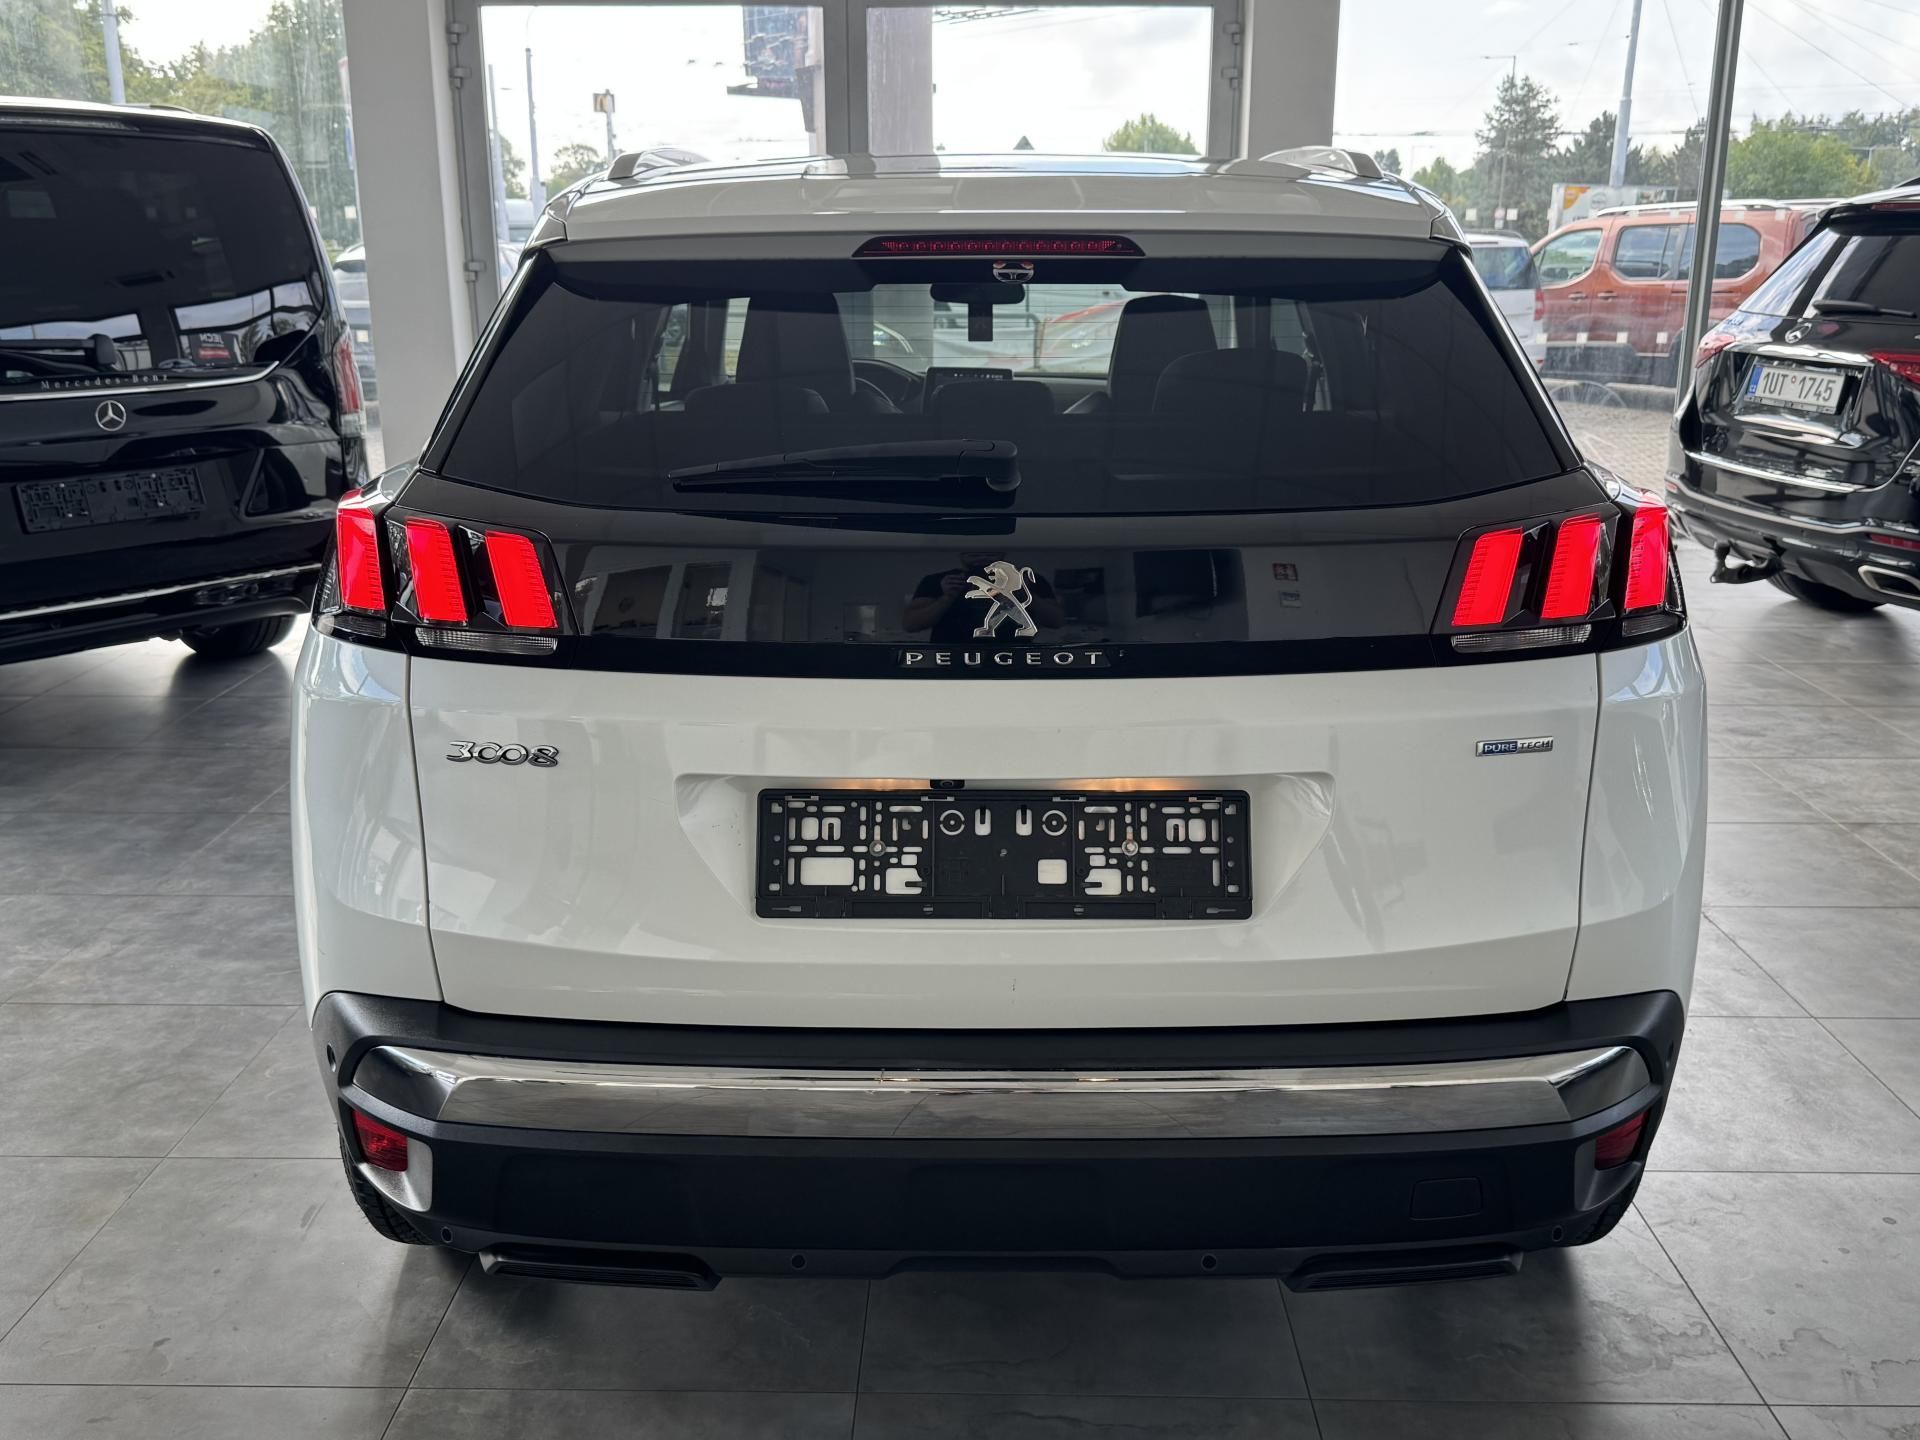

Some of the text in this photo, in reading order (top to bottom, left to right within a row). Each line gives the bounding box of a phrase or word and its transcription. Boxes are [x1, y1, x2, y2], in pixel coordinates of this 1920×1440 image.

[41, 374, 168, 390] Mercedes-Benz
[1763, 371, 1789, 396] 1UT
[1799, 376, 1836, 402] 1745
[906, 652, 1102, 666] PEUGEOT
[446, 740, 559, 768] 3008
